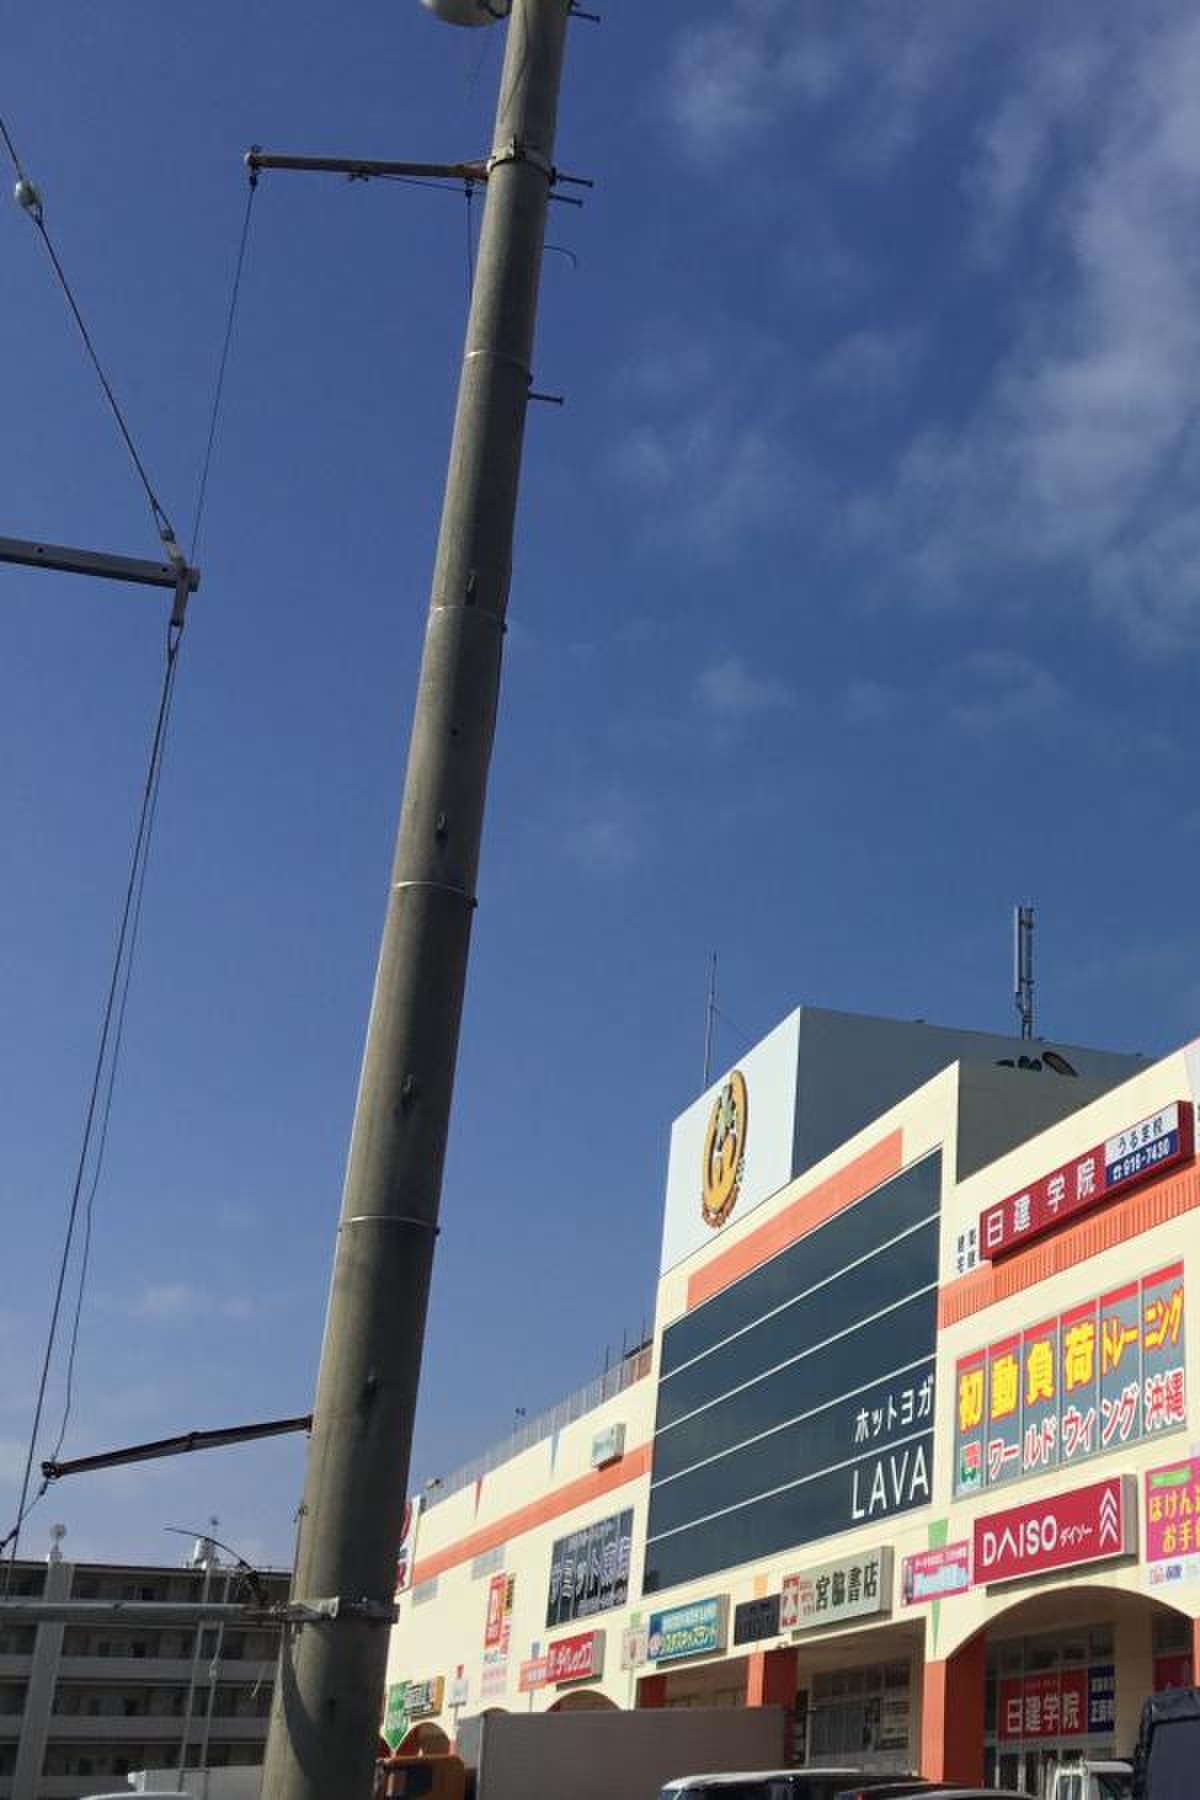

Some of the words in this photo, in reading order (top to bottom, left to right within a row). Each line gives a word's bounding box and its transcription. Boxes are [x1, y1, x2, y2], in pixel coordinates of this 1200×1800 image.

[1116, 1116, 1164, 1156] うるま校
[987, 1158, 1096, 1247] 日建学院
[855, 1375, 934, 1443] ホットヨガ
[852, 1444, 928, 1519] LAVA
[982, 1515, 1057, 1567] DAISO
[1008, 1692, 1080, 1733] 日建学院
